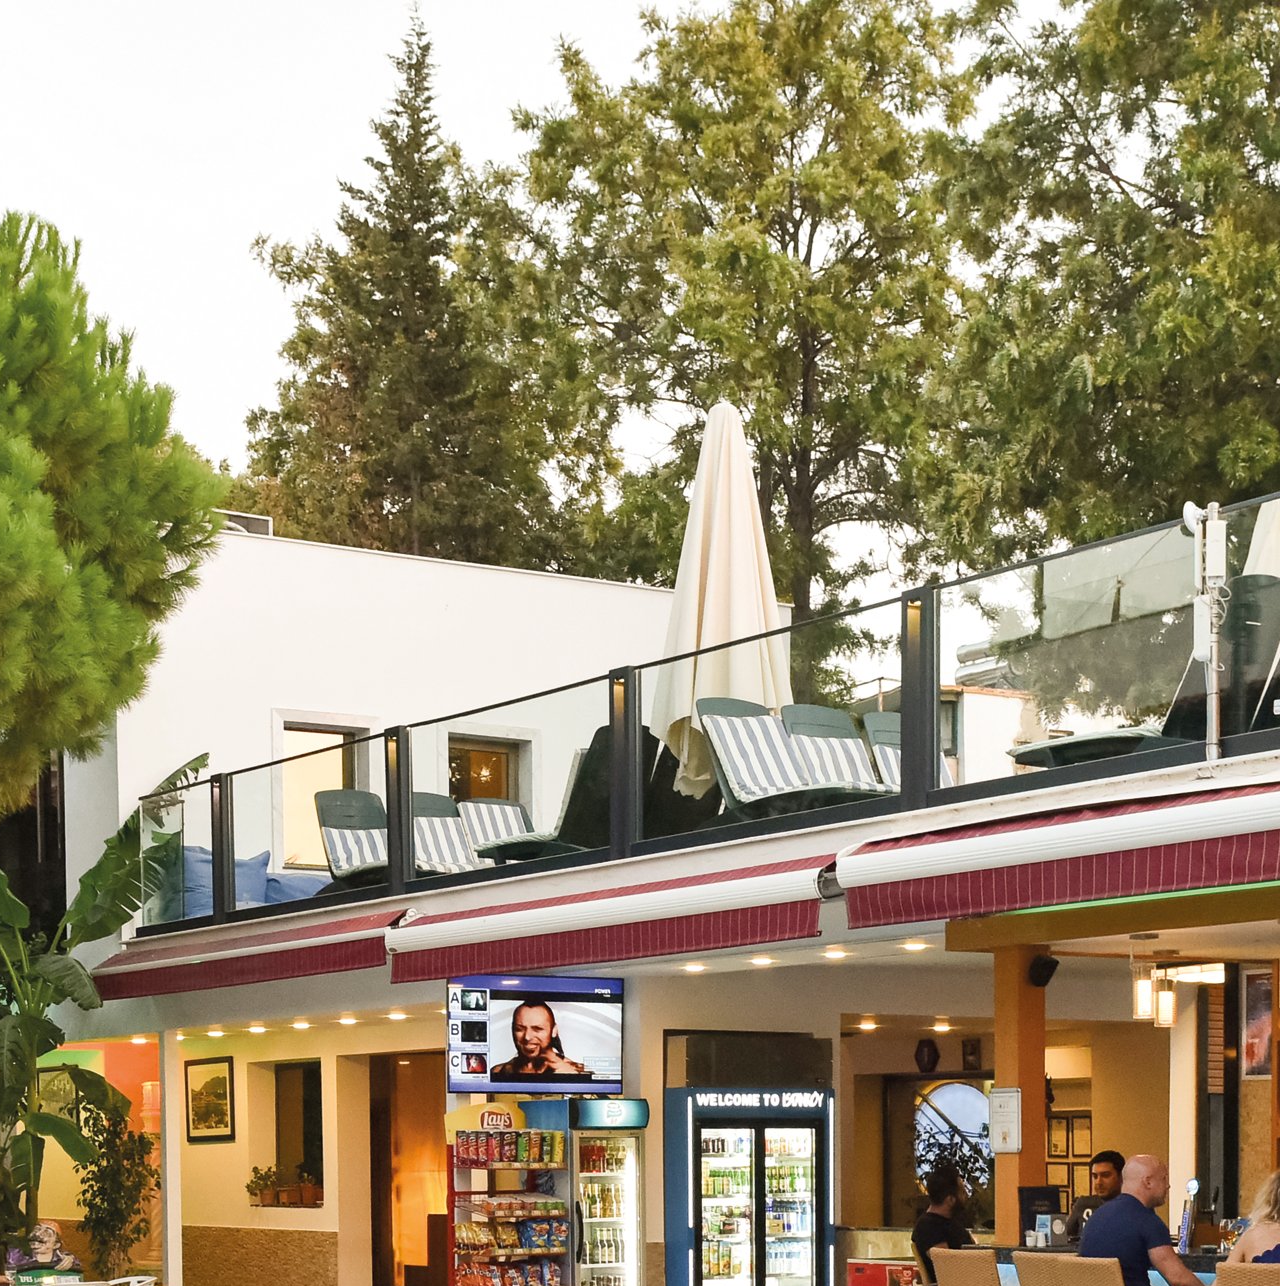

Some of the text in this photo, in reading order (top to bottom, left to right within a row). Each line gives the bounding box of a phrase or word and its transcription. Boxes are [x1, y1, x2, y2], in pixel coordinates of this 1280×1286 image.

[450, 991, 460, 1004] A
[450, 1023, 460, 1036] B
[450, 1055, 460, 1068] C
[696, 1093, 760, 1107] WELCOME
[763, 1093, 780, 1107] TO
[483, 1112, 512, 1130] Lay's
